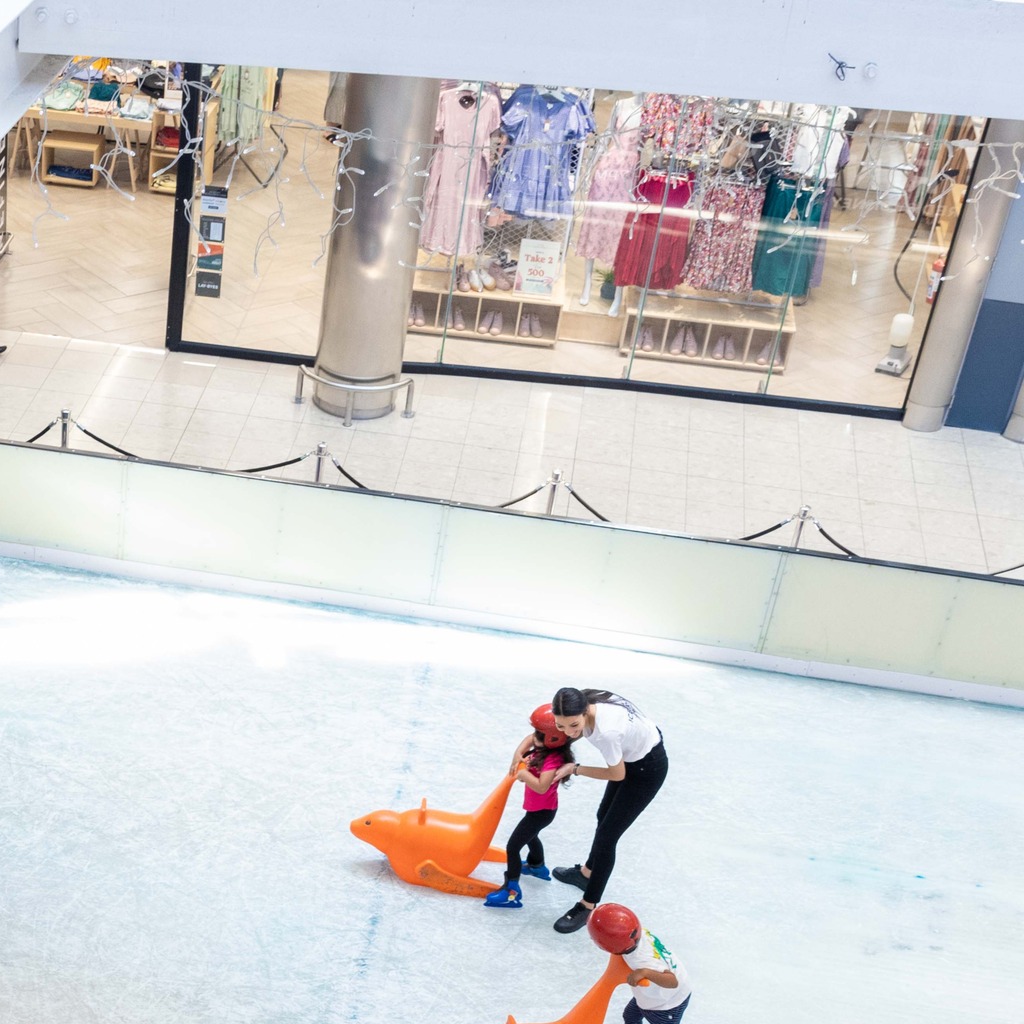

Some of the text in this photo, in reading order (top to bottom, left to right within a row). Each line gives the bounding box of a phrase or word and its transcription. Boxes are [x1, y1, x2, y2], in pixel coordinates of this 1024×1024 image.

[525, 254, 554, 264] Take 2
[528, 268, 545, 277] 500
